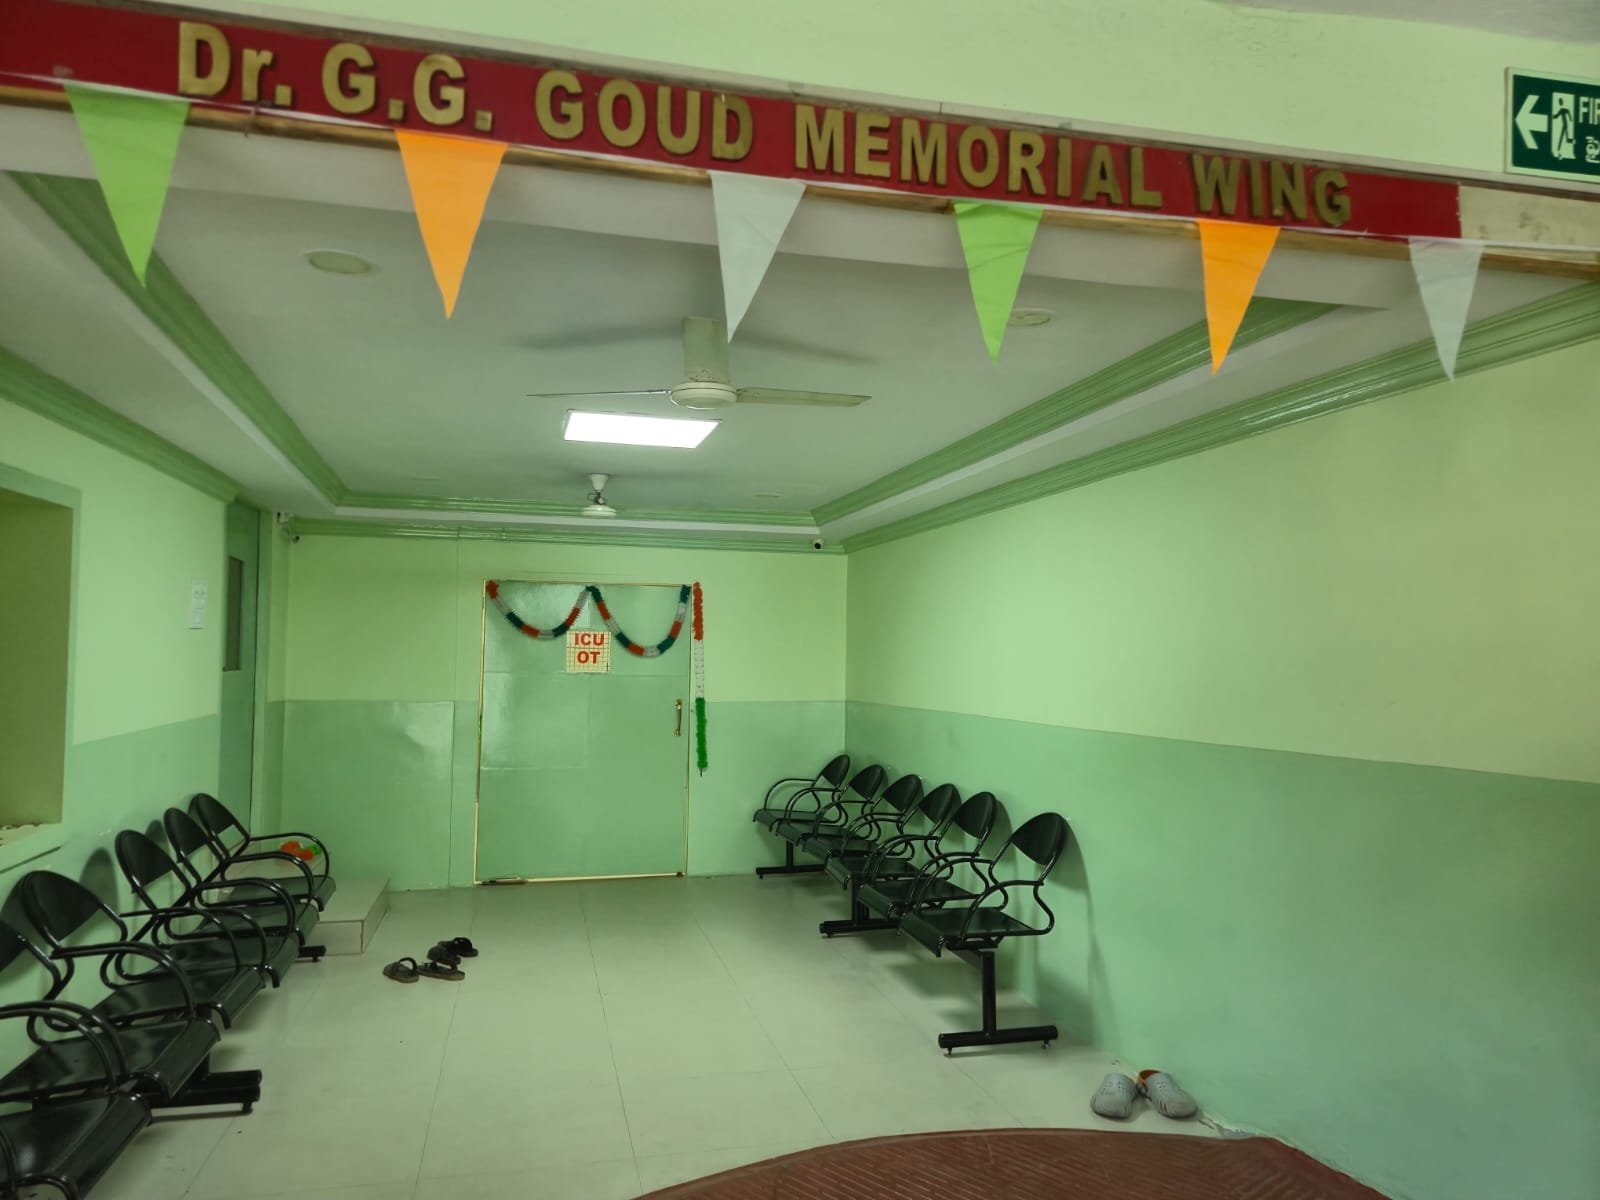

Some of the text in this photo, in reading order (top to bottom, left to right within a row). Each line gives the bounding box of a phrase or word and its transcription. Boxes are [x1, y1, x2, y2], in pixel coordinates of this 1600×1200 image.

[178, 21, 292, 106] Dr.
[535, 70, 753, 160] GOUD
[795, 104, 1163, 207] MEMORIAL
[1192, 153, 1351, 227] WING
[574, 632, 605, 646] ICU
[577, 650, 601, 664] OT
